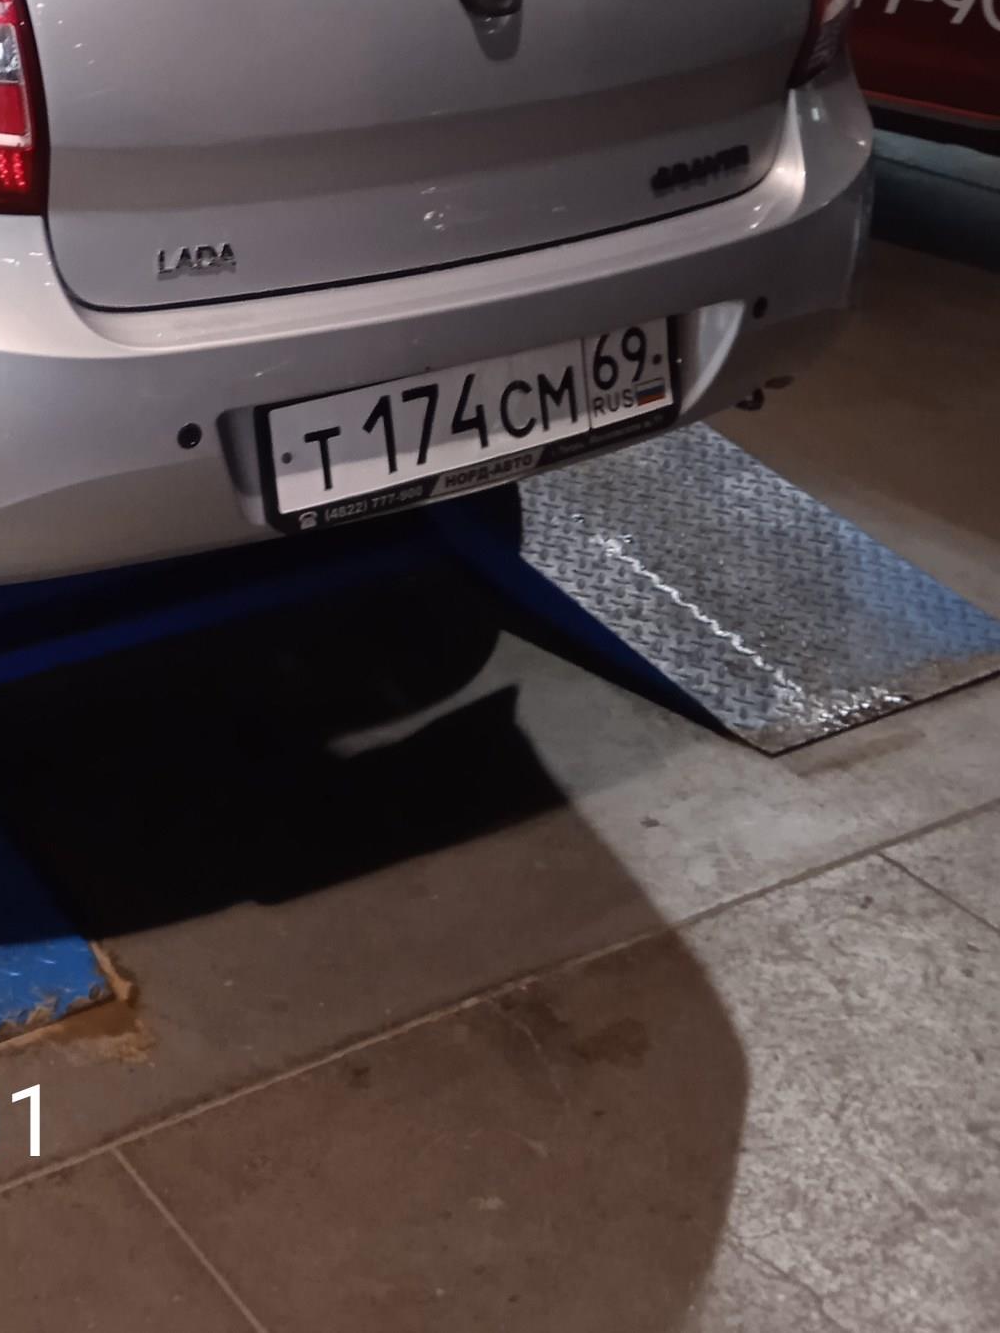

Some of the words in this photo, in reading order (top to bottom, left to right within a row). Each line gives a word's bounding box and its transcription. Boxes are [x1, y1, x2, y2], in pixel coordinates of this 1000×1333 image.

[158, 243, 236, 275] LADA
[593, 327, 647, 390] 69
[593, 388, 634, 417] RUS
